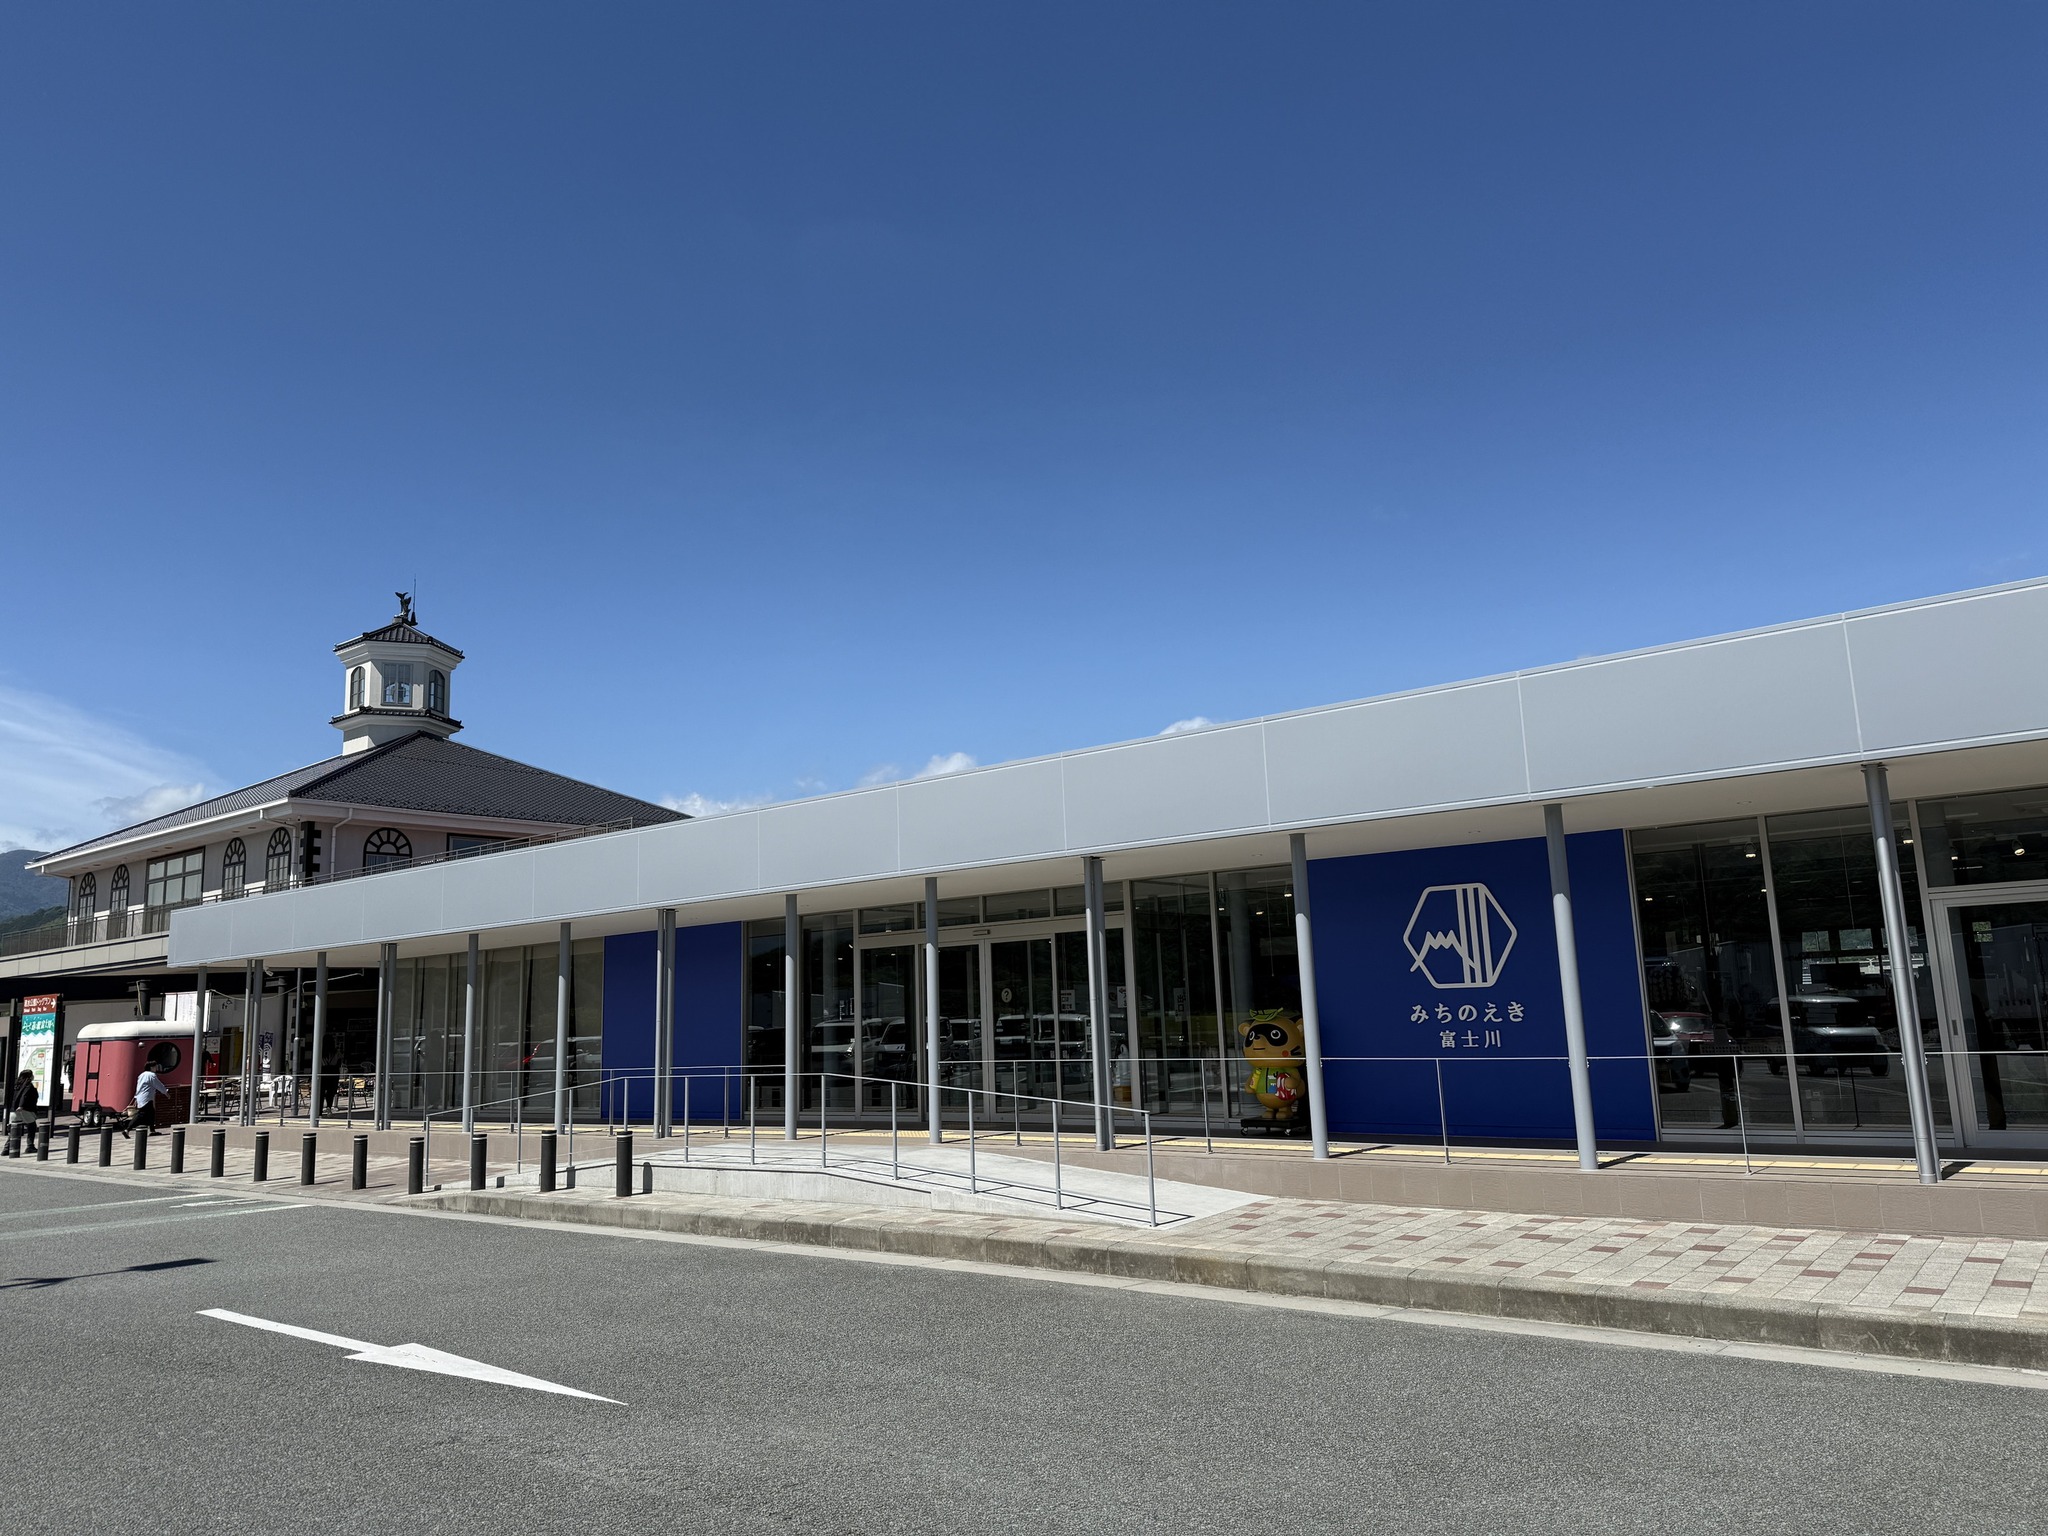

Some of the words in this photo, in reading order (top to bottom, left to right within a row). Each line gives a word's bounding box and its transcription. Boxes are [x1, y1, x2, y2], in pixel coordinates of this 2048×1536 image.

[1410, 1001, 1525, 1024] みちのえき
[1440, 1029, 1501, 1048] 富士川
